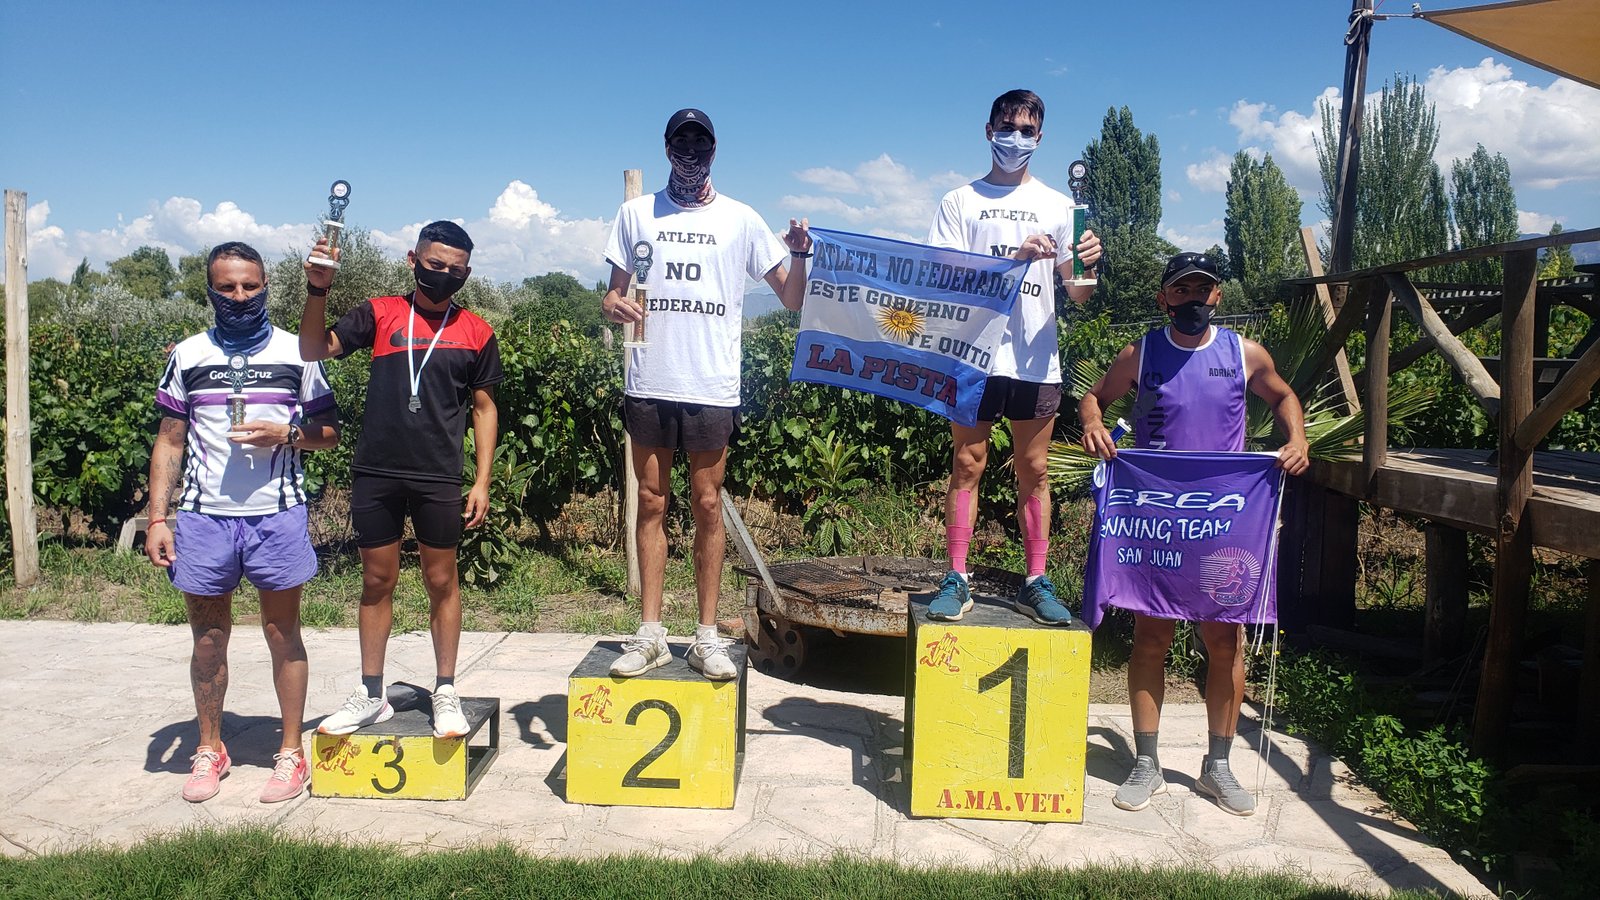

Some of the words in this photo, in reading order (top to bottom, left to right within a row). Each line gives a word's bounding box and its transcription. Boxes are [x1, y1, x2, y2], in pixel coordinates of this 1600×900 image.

[979, 209, 1039, 223] ATLETA
[656, 231, 717, 245] ATLETA
[990, 244, 1019, 258] N
[665, 262, 701, 281] NO
[813, 241, 878, 278] ATLETA
[886, 256, 914, 285] NO
[915, 259, 1015, 301] FEDERADO
[646, 298, 726, 316] EDERADO
[809, 281, 860, 302] ESTE
[866, 289, 970, 322] GOBIERNO
[907, 331, 933, 349] TE
[938, 336, 992, 370] QUITÓ
[247, 369, 272, 379] Cruz
[806, 344, 854, 376] LA
[859, 355, 958, 407] PISTA
[1102, 488, 1246, 512] EREA
[1177, 518, 1231, 540] TEAM
[1117, 547, 1142, 564] SAN
[1149, 550, 1182, 567] JUAN
[978, 648, 1028, 779] 1
[621, 698, 682, 789] 2
[371, 739, 407, 795] 3
[936, 788, 1072, 814] A.MA.VET.
